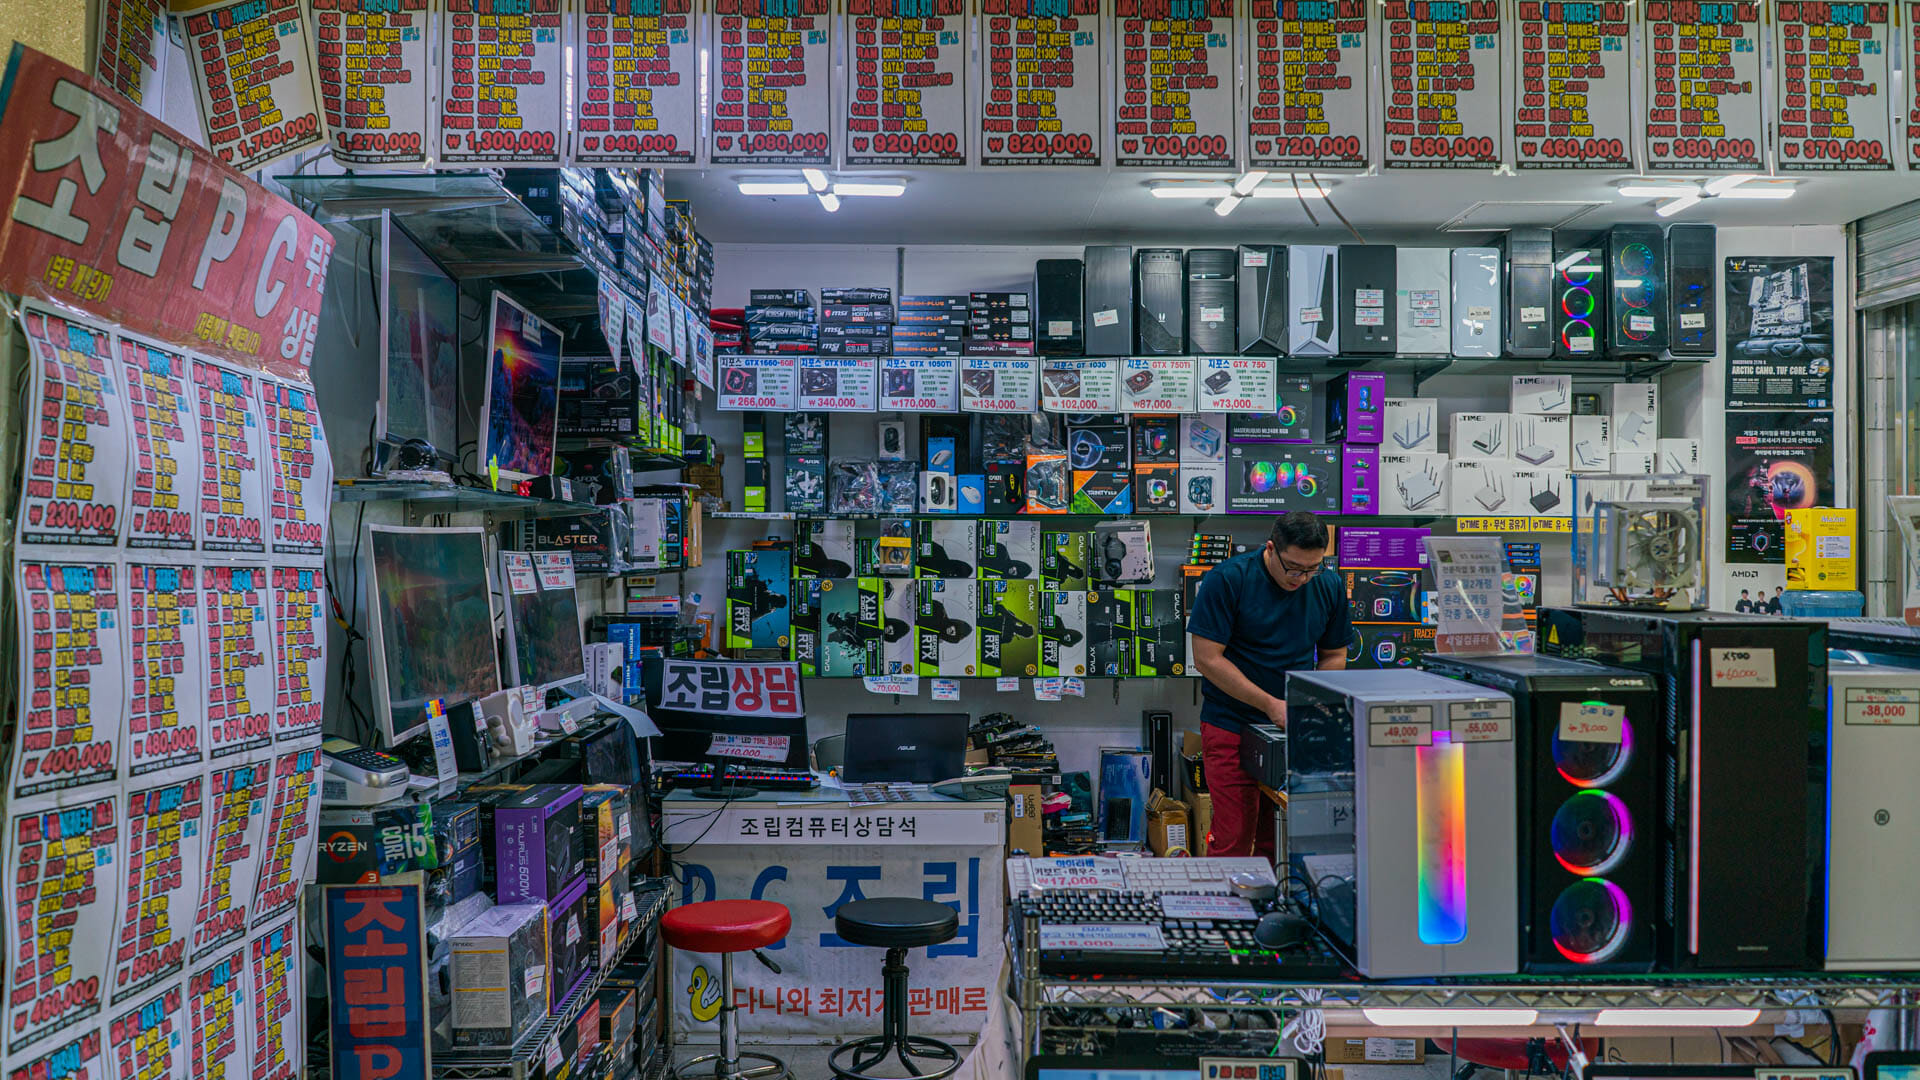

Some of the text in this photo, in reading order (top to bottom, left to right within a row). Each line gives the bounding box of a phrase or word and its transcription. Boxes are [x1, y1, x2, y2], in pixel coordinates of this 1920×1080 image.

[1339, 2, 1364, 19] NO.11
[1471, 2, 1497, 19] NO.10
[320, 12, 341, 26] CPU
[453, 14, 474, 27] CPU
[1257, 21, 1278, 34] CPU
[1784, 24, 1804, 37] CPU
[1258, 35, 1278, 48] M/B
[452, 57, 501, 70] SSD SATA3
[1258, 50, 1280, 63] RAM
[721, 60, 742, 73] HDD
[1258, 64, 1306, 77] SSD SATA3
[1258, 78, 1280, 91] VGA
[452, 86, 473, 99] ODD
[446, 100, 473, 114] CASE
[1252, 107, 1280, 120] CASE
[210, 115, 236, 129] CASE
[260, 109, 283, 127] POWER
[366, 116, 390, 129] POWER
[443, 116, 474, 129] POWER
[498, 116, 522, 129] POWER
[238, 113, 317, 157] 1,750,000
[1250, 122, 1281, 135] POWER
[1305, 122, 1329, 135] POWER
[1830, 125, 1854, 138] POWER
[337, 132, 421, 152] 1,270,000
[466, 131, 555, 154] 1,300,000
[603, 134, 678, 155] 940,000
[738, 133, 828, 155] 1,080,000
[873, 133, 957, 156] 920,000
[1008, 133, 1092, 157] 820,000
[1142, 135, 1226, 158] 700,000
[1275, 136, 1360, 160] 720,000
[1410, 136, 1494, 160] 560,000
[1541, 139, 1623, 161] 460,000
[1673, 138, 1756, 161] 380,000
[1803, 139, 1883, 163] 370,000
[801, 358, 822, 368] 지포스
[886, 359, 907, 369] 지포스
[910, 360, 924, 368] GTX
[970, 359, 1029, 369] 지포스 GTX 1050
[1089, 361, 1107, 369] 1030
[1127, 359, 1149, 369] 지포스
[1152, 361, 1166, 369] GTX
[1208, 359, 1266, 369] 지포스 GTX 750
[1731, 366, 1754, 375] ARCTIC
[46, 500, 116, 532] 230,000
[538, 534, 599, 546] BLASTER
[866, 593, 876, 621] RTX
[734, 606, 745, 633] RTX
[985, 634, 995, 659] RTX
[665, 665, 797, 713] 조립상담
[740, 816, 917, 838] 조립컴퓨터상담석
[318, 841, 368, 852] RYZEN
[381, 822, 428, 862] CORE i5
[733, 986, 810, 1016] 다나와
[909, 986, 988, 1016] 판매로
